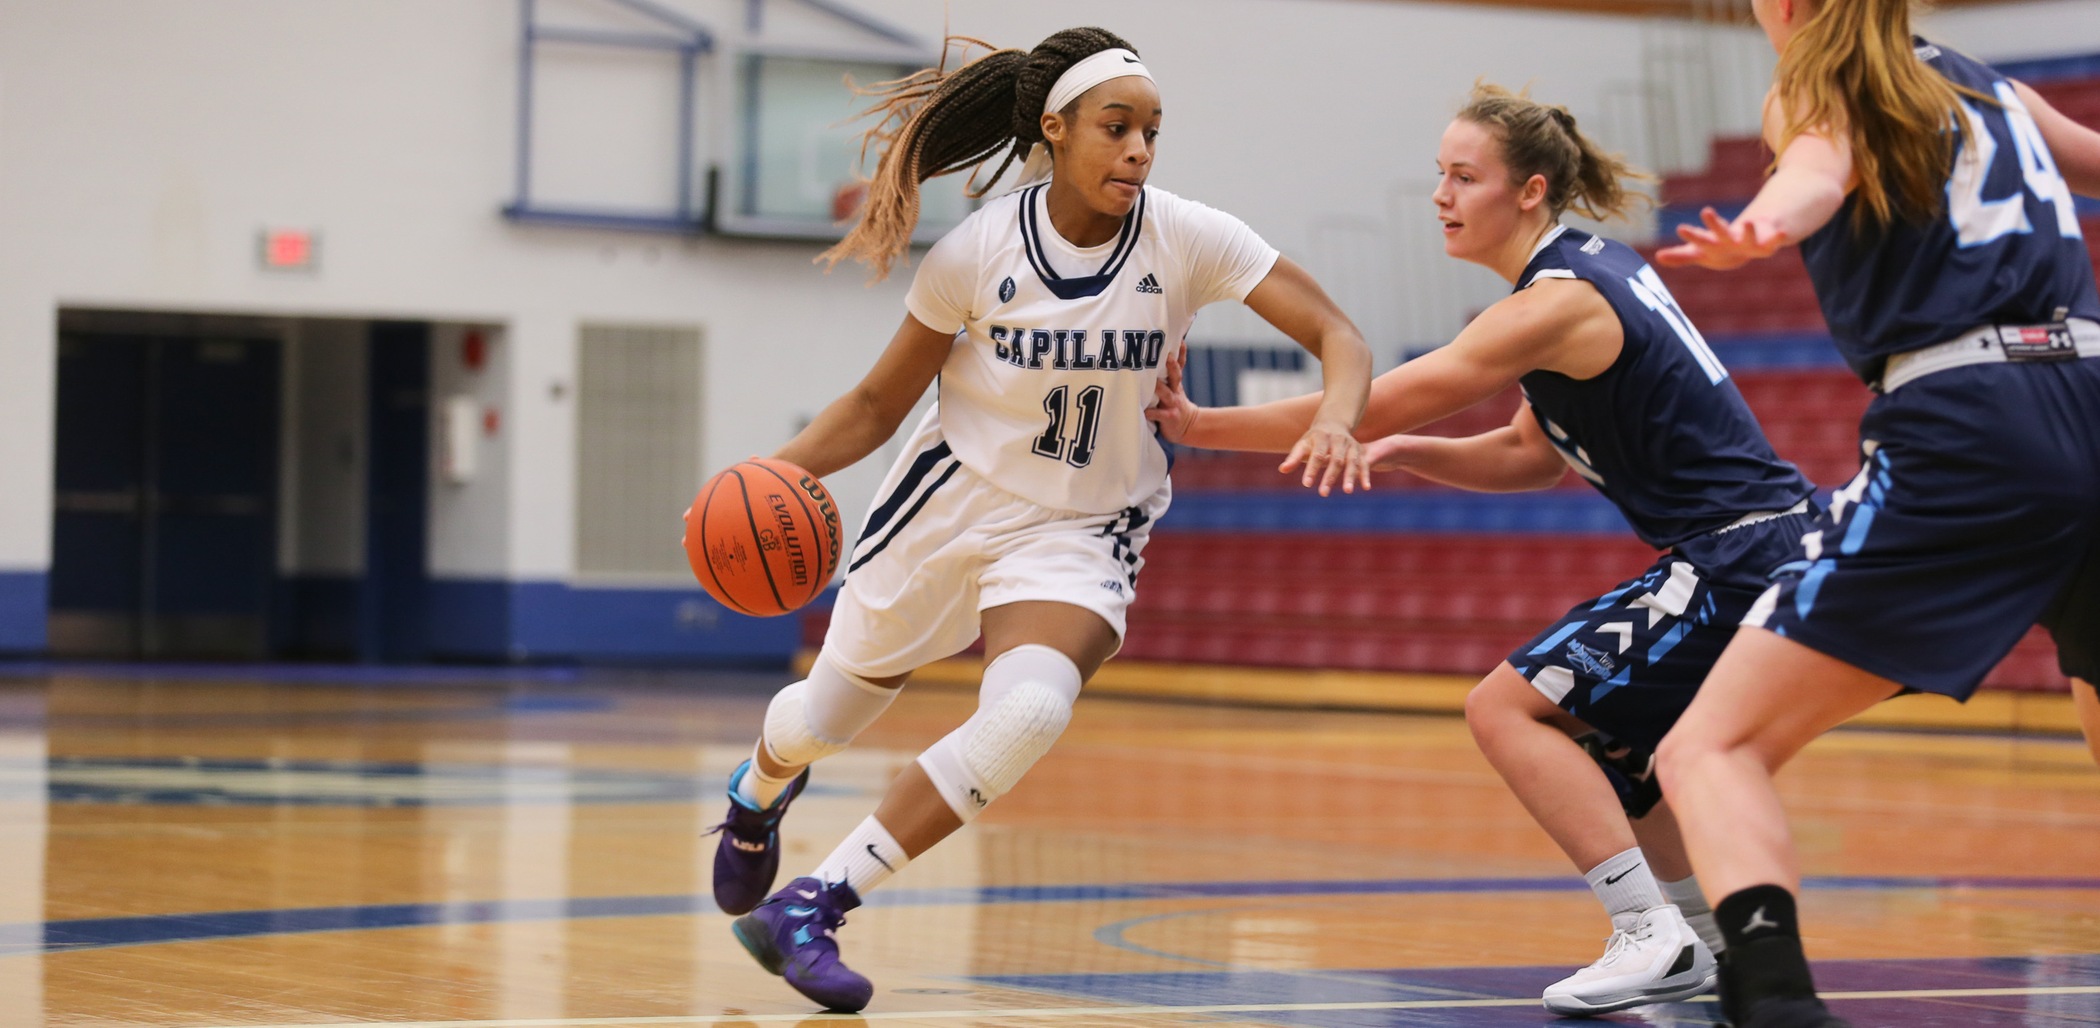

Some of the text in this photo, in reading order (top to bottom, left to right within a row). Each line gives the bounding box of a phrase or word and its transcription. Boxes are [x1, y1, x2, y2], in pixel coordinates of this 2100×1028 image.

[1940, 81, 2083, 249] 24
[1135, 284, 1163, 295] adidas
[989, 324, 1166, 371] CAPILANO
[1031, 385, 1104, 469] 11
[759, 528, 776, 552] GB
[768, 493, 808, 586] EVOLUTION
